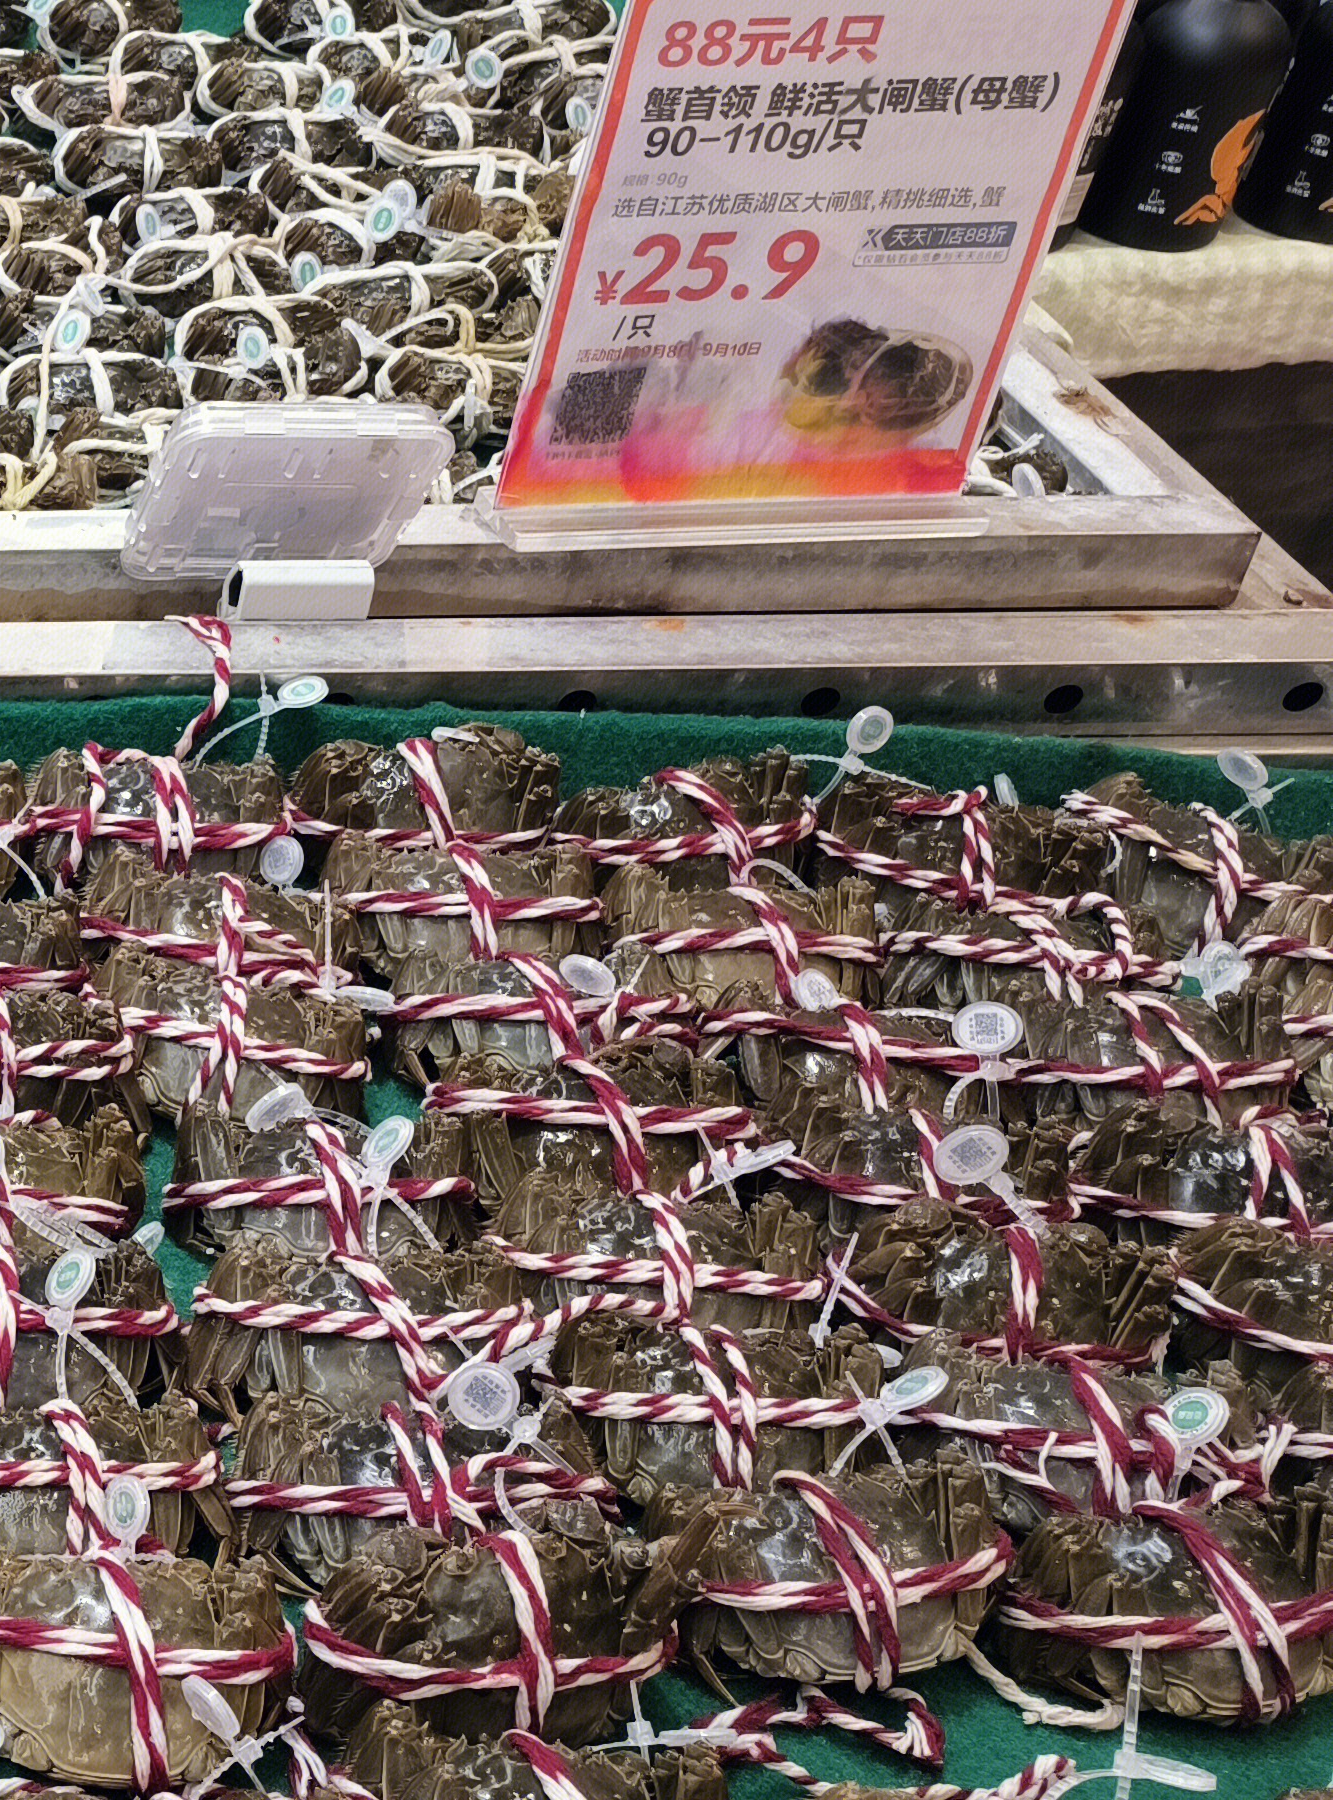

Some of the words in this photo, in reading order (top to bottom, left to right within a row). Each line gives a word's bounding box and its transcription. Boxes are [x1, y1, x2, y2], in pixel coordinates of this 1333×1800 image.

[656, 14, 886, 69] 88元4只
[888, 225, 1008, 247] 天天门店88折
